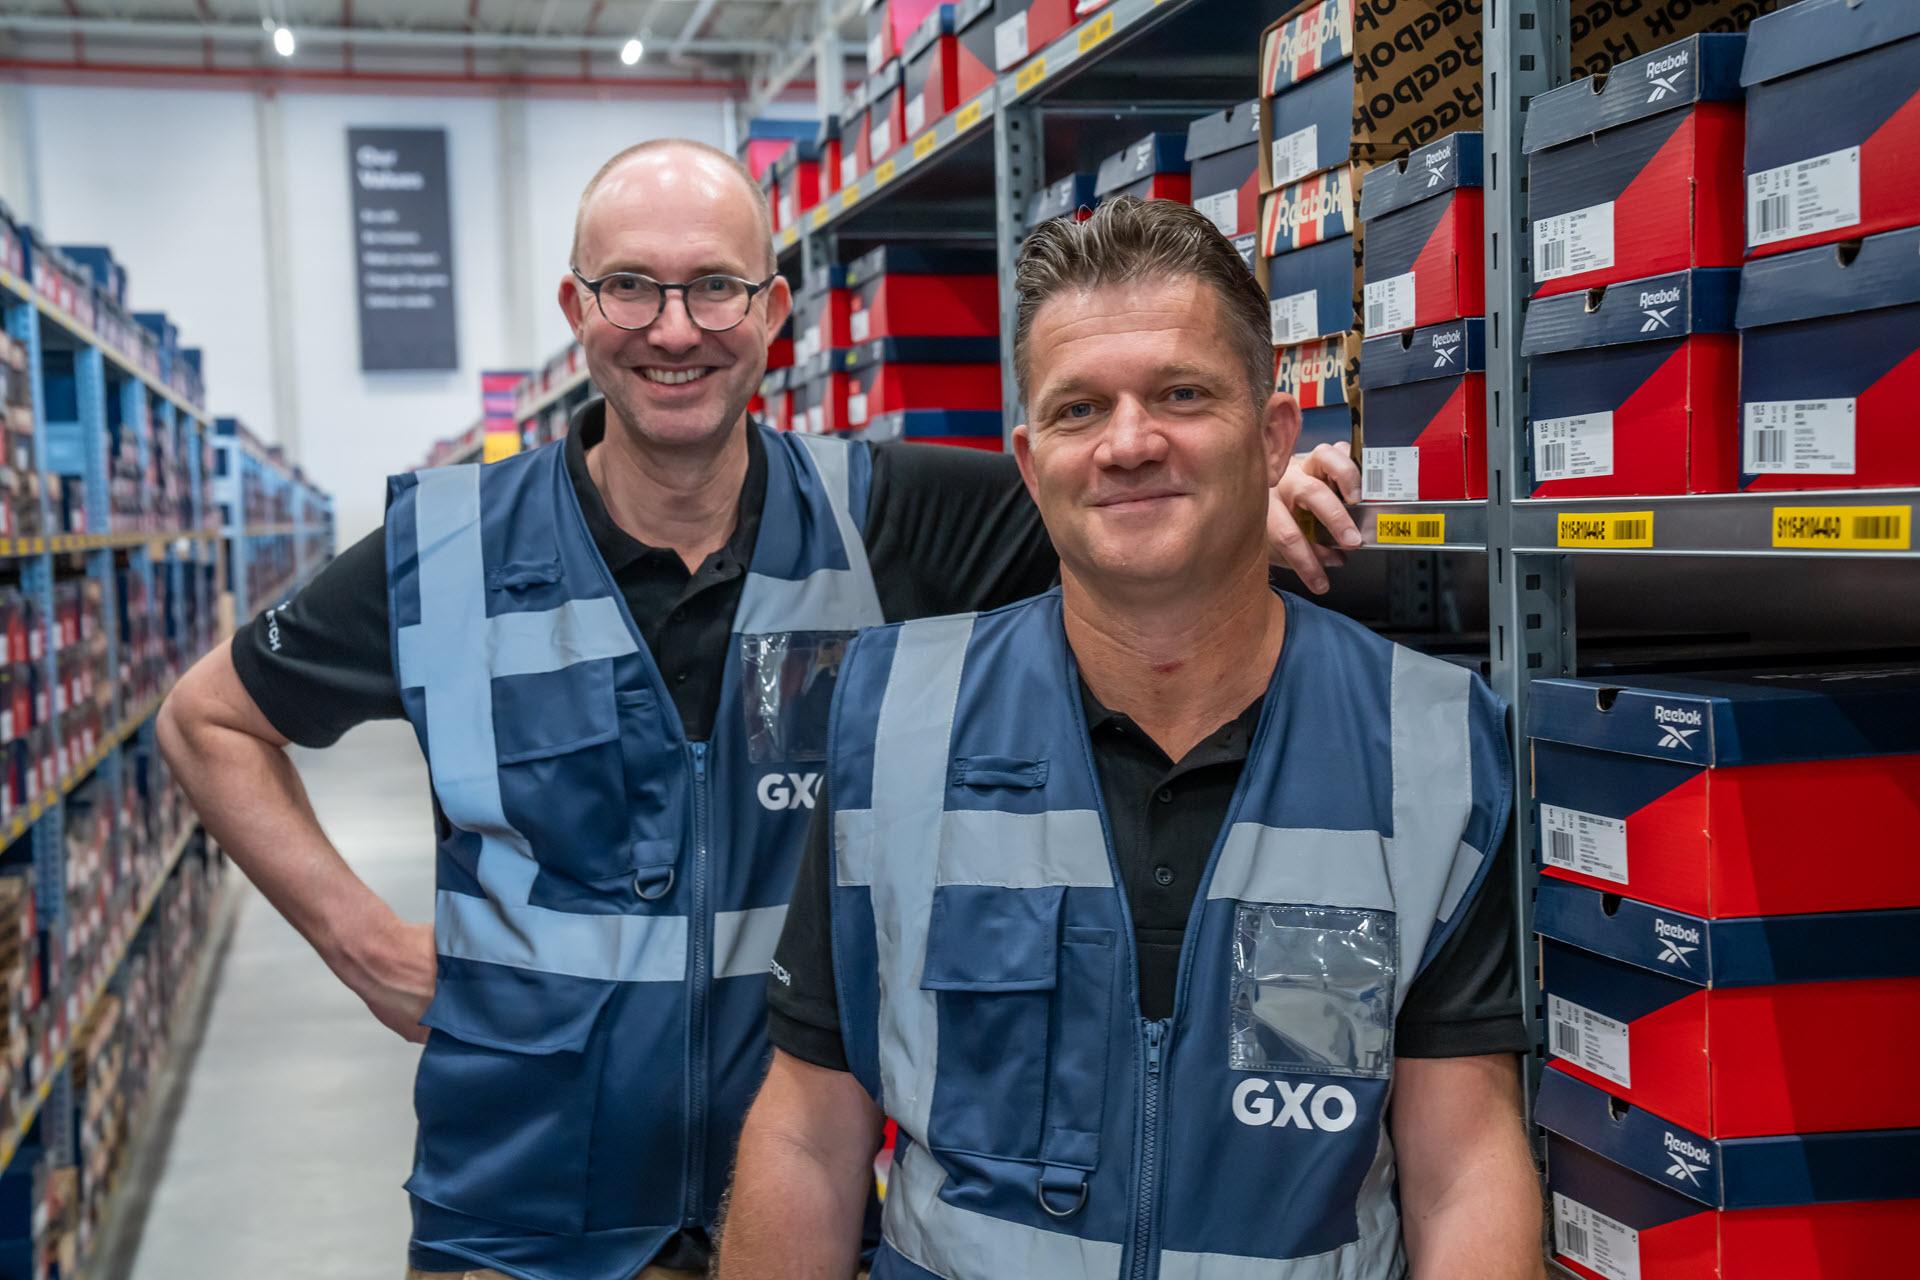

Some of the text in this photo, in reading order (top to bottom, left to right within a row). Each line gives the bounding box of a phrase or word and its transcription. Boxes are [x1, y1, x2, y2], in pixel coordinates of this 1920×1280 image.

[1646, 51, 1690, 79] Reebok
[1426, 146, 1451, 168] Reebok
[1277, 182, 1342, 237] Reebok
[1640, 287, 1681, 308] Reebok
[1432, 329, 1461, 348] Reebok
[1275, 349, 1345, 392] Reebok
[1655, 705, 1702, 726] Reebok
[757, 773, 824, 811] GX
[1655, 918, 1700, 945] Reebok
[1232, 1078, 1357, 1133] GXO
[1664, 1131, 1711, 1166] Reebok
